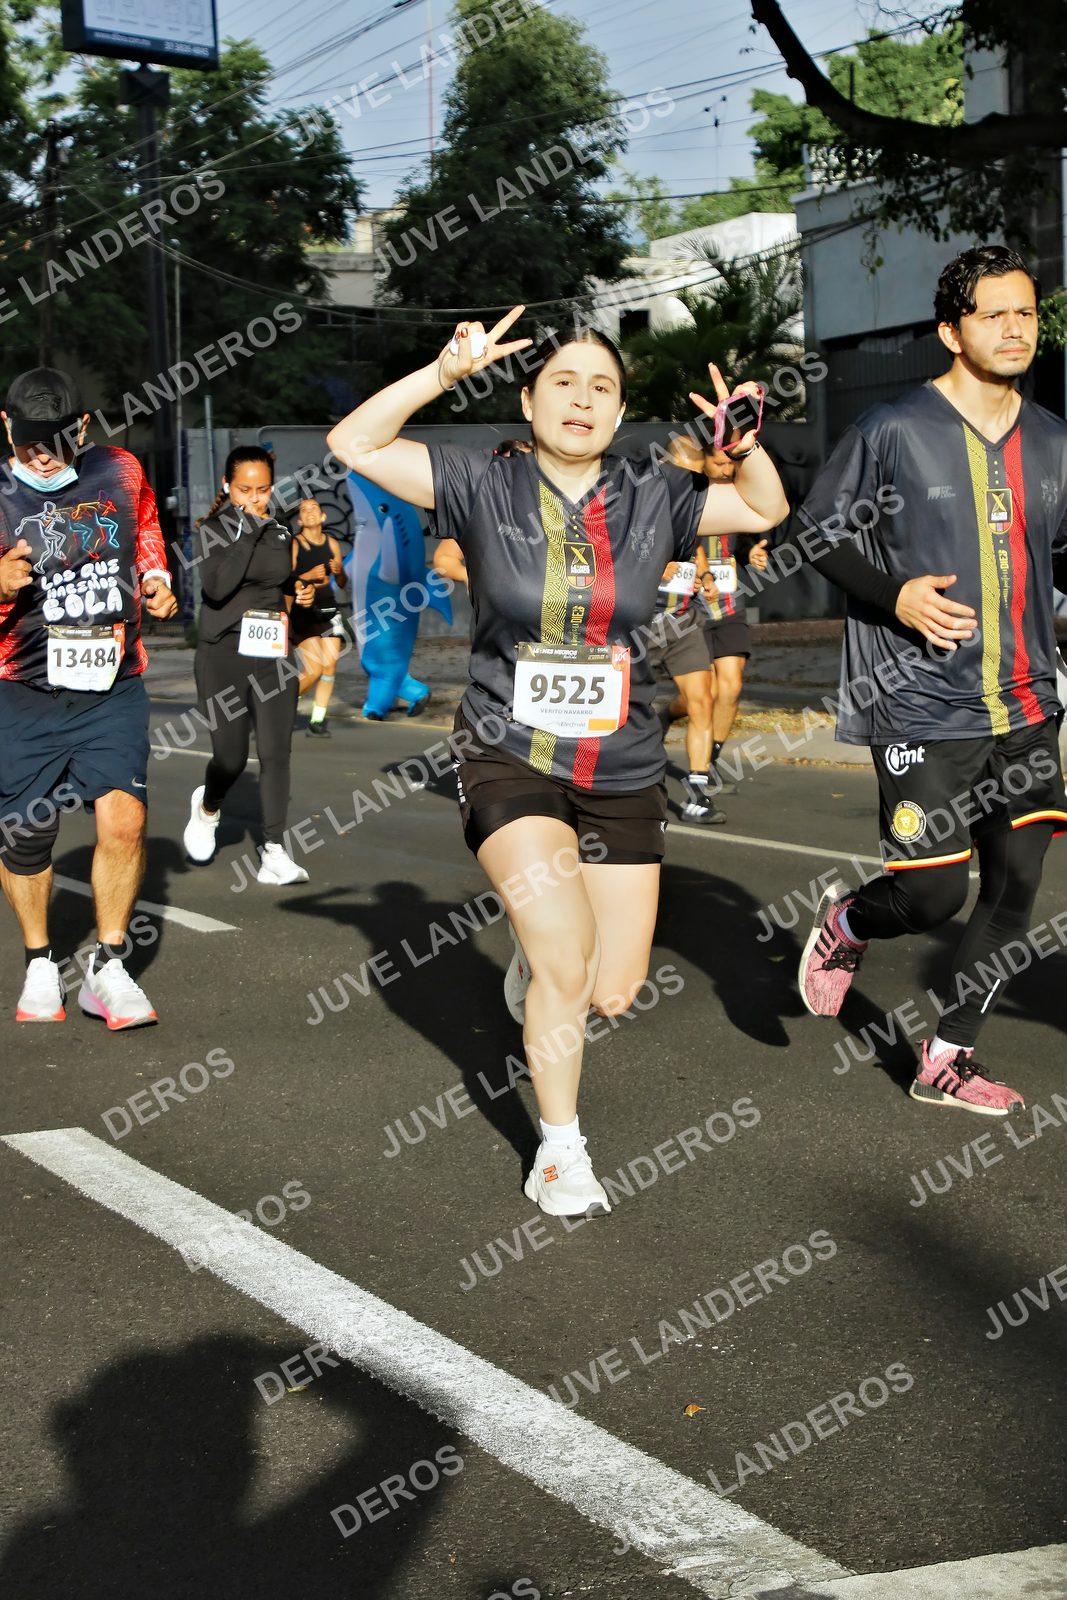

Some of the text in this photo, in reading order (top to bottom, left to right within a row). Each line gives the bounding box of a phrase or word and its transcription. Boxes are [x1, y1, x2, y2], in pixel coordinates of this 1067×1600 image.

[81, 558, 120, 578] QUE
[248, 624, 279, 641] 8063
[53, 646, 117, 668] 13484
[530, 673, 605, 705] 9525
